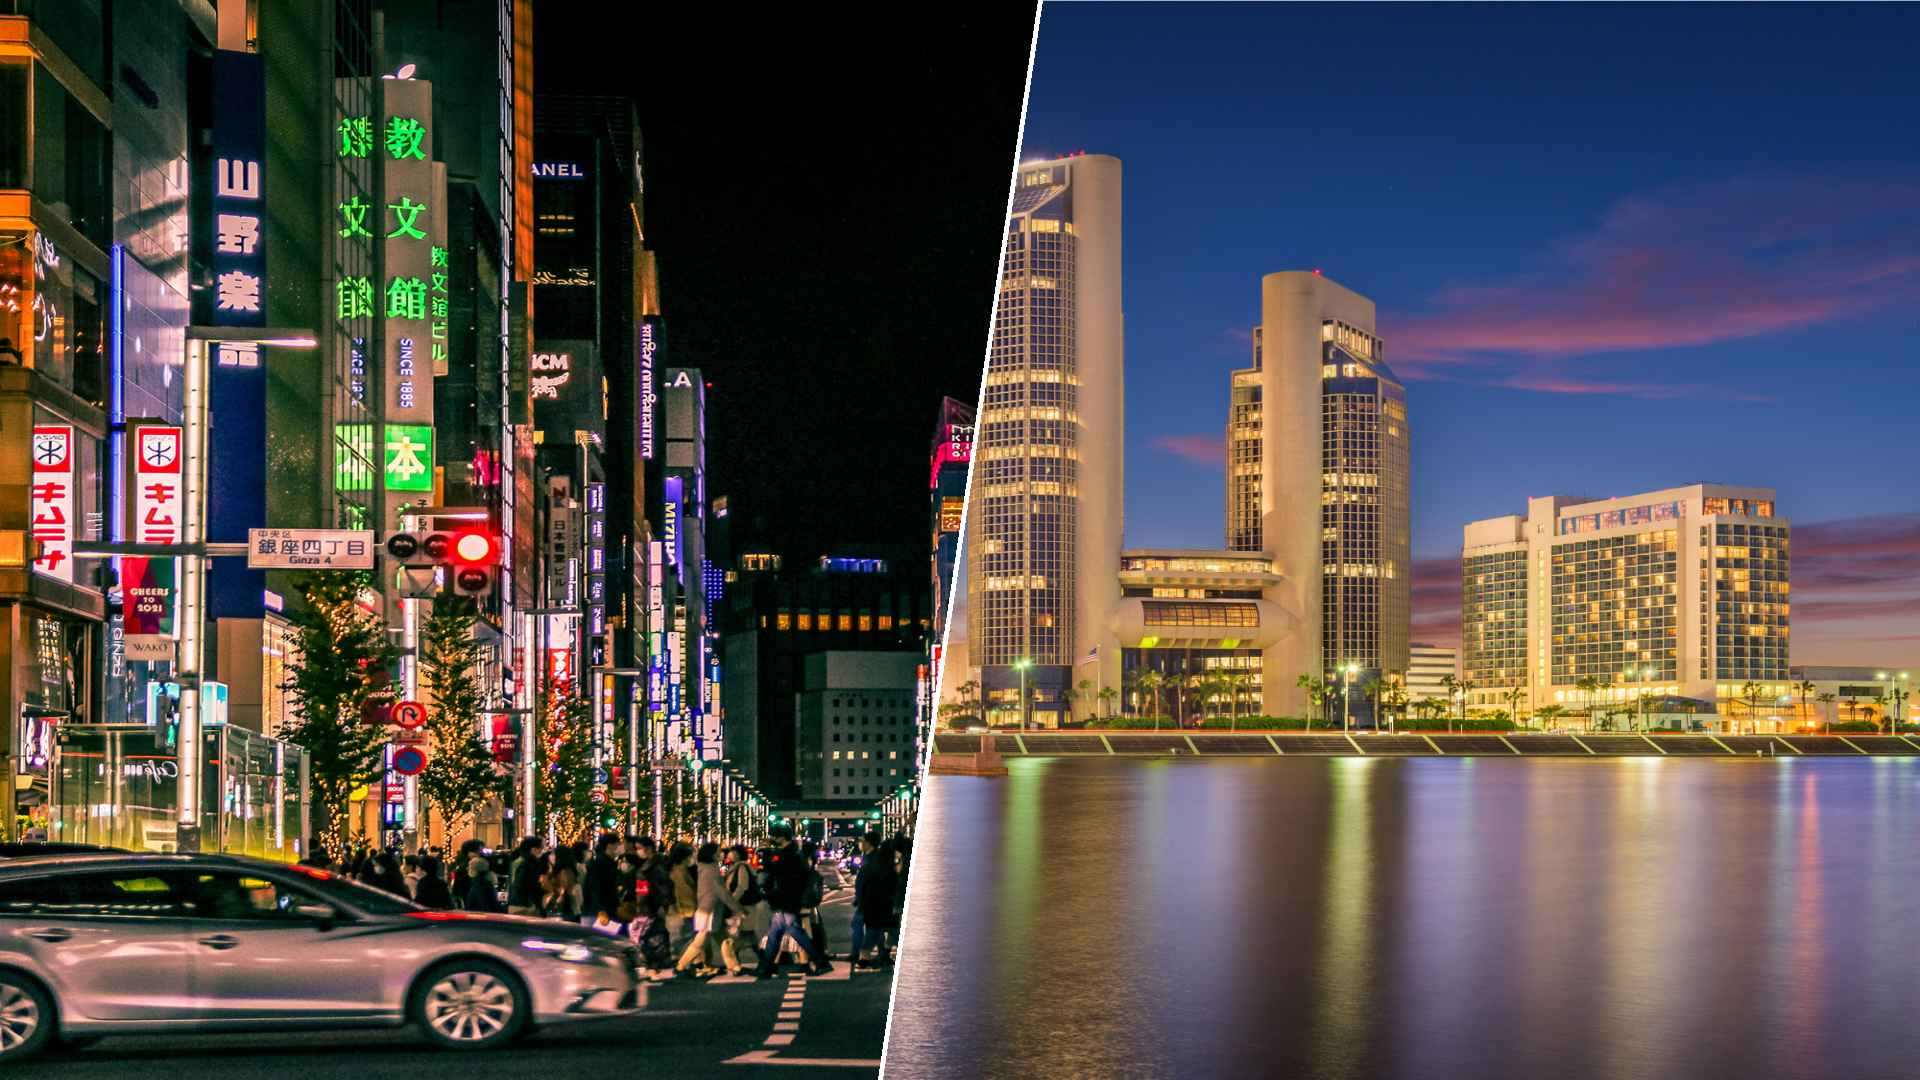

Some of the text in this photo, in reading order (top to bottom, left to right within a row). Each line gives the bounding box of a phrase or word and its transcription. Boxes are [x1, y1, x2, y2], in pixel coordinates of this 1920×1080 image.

[384, 115, 428, 321] 教文館
[400, 338, 414, 408] SINCE 1885
[386, 436, 426, 481] 本
[258, 530, 291, 539] 中央区
[258, 540, 365, 555] 銀座四丁目
[289, 556, 320, 564] Ginza
[130, 588, 169, 596] CHEERS
[137, 604, 162, 612] 2021
[133, 643, 168, 652] WAKO
